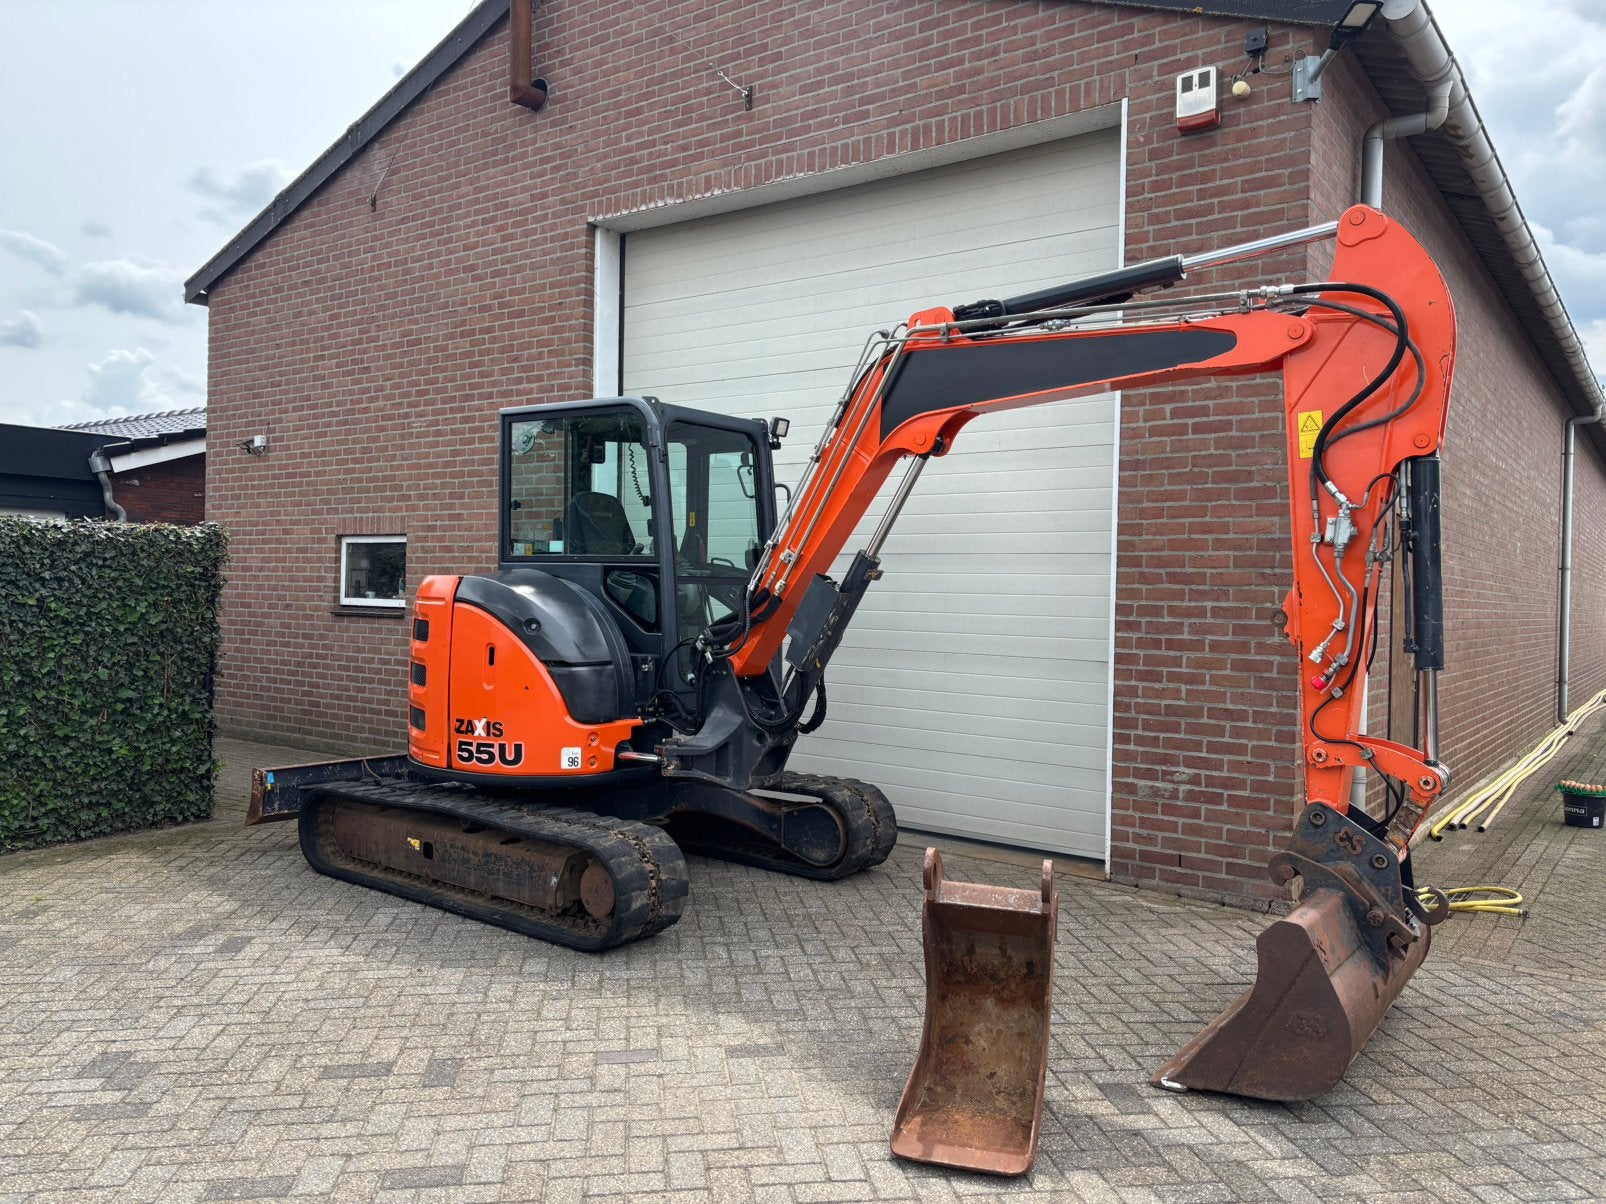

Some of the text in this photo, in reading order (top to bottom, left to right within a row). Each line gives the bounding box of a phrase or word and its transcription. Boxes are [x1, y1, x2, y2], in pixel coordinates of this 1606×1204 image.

[455, 717, 504, 738] ZAXIS
[457, 740, 523, 767] 55U
[567, 756, 579, 767] 96
